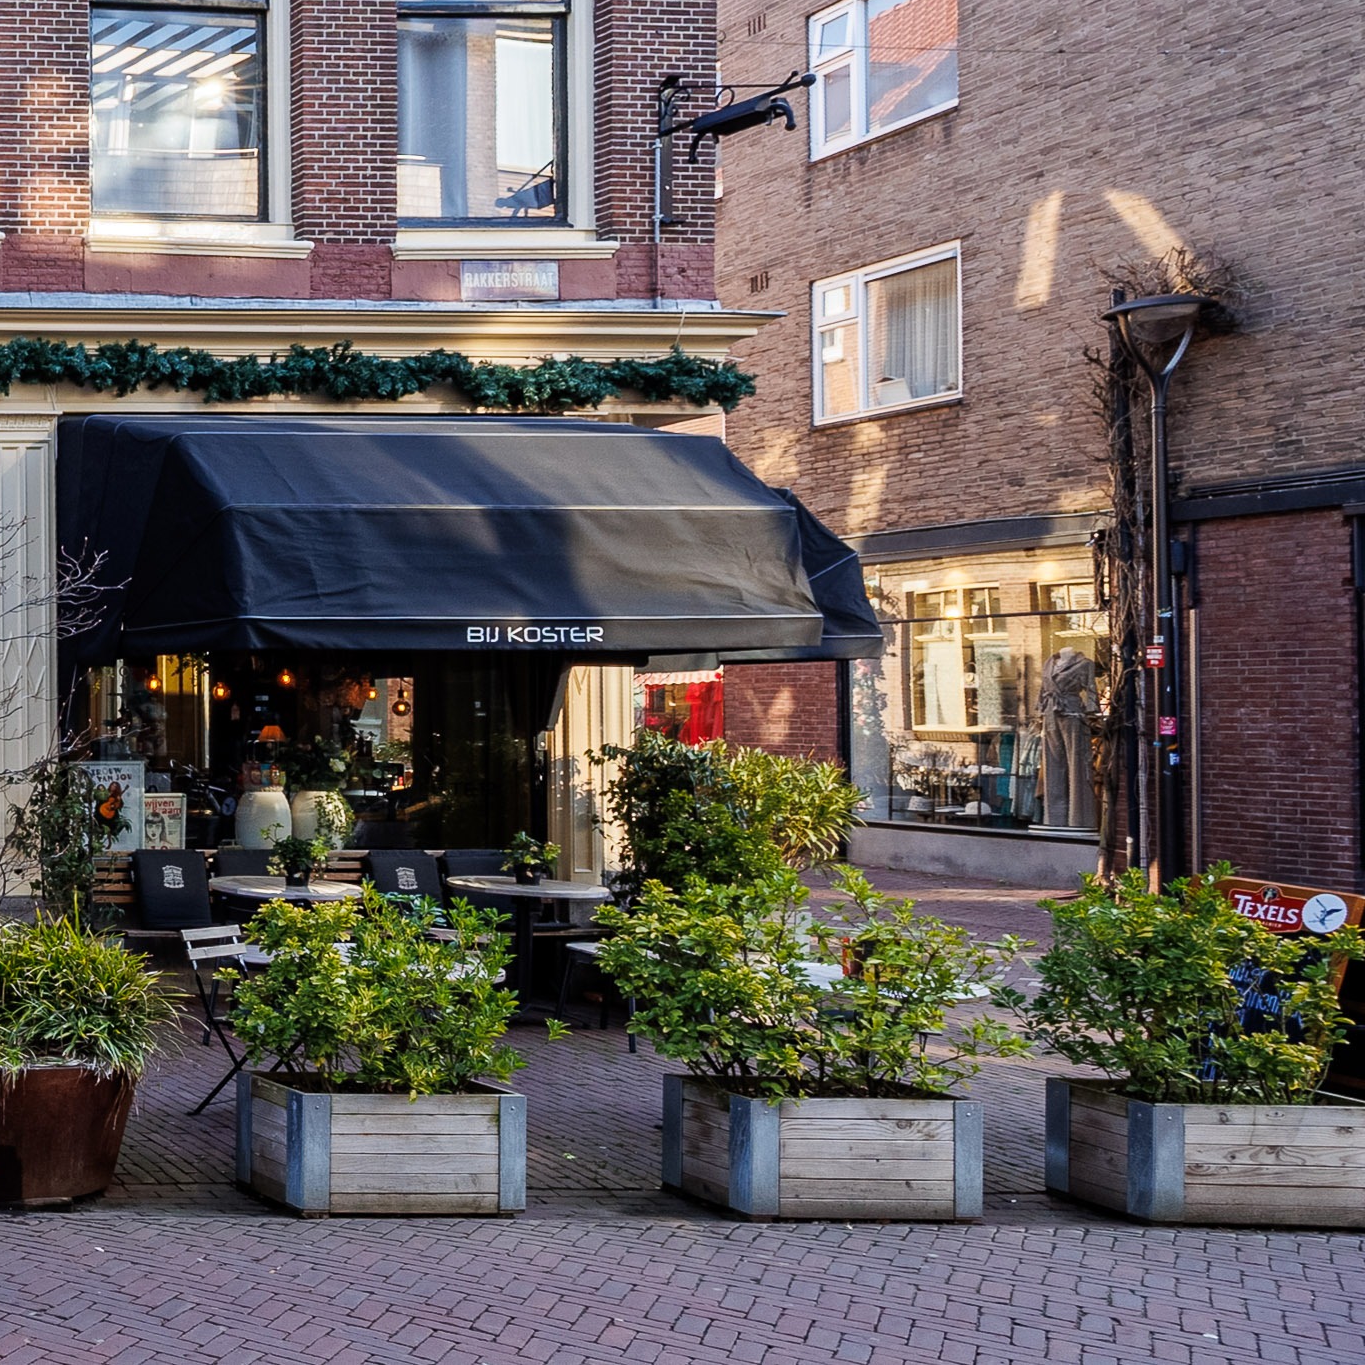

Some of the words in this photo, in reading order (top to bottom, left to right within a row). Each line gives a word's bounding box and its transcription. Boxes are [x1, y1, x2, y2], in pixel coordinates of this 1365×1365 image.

[464, 272, 554, 288] BAKKERSTRAAT
[467, 626, 500, 643] BIJ
[507, 626, 604, 643] KOSTER
[143, 799, 175, 812] wijven
[1233, 893, 1300, 925] TEXELS
